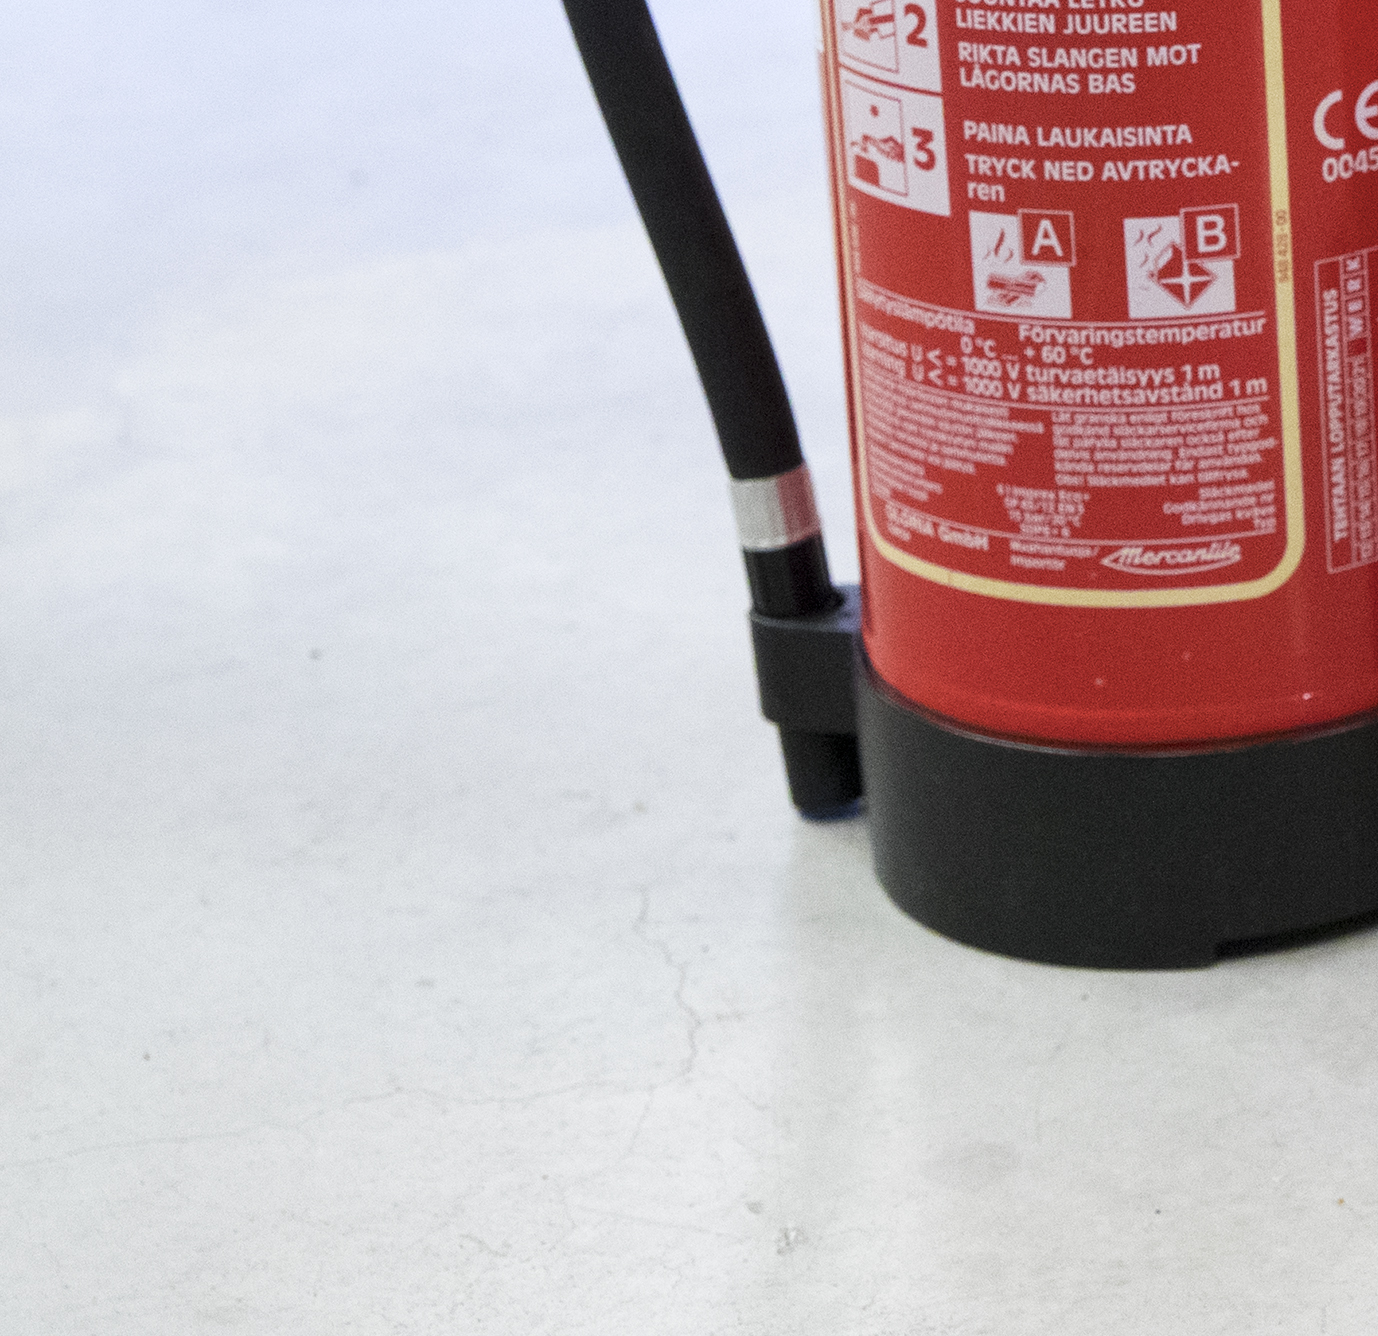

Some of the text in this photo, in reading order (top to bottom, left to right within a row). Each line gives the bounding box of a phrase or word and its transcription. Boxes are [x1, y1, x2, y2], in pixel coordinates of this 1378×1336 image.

[905, 3, 928, 48] 2
[955, 7, 1177, 35] LIEKKIEN JUUREEN
[958, 41, 1201, 69] RIKTA SLANGEN MOT
[960, 66, 1136, 94] LÅGORNAS BAS
[963, 120, 1192, 148] PAINA LAUKAISINTA
[911, 127, 935, 172] 3
[965, 153, 1240, 182] TRYCK NED AVTRYCKA-
[967, 180, 1005, 202] ren
[1032, 219, 1063, 257] A
[1196, 214, 1228, 253] B
[1018, 317, 1266, 349] Förvaringstemperatur
[961, 336, 973, 353] 0
[1041, 345, 1066, 363] 60
[962, 356, 1002, 378] 1000
[1006, 362, 1020, 379] V
[1026, 364, 1174, 386] turvaetäisyys
[1199, 364, 1220, 379] m
[964, 376, 1003, 399] 1000
[1007, 383, 1021, 400] V
[1026, 379, 1223, 405] säkerhetsavstånd
[1246, 376, 1267, 394] m
[1323, 288, 1349, 542] TEHTAAN LOPPUTARKASTUS
